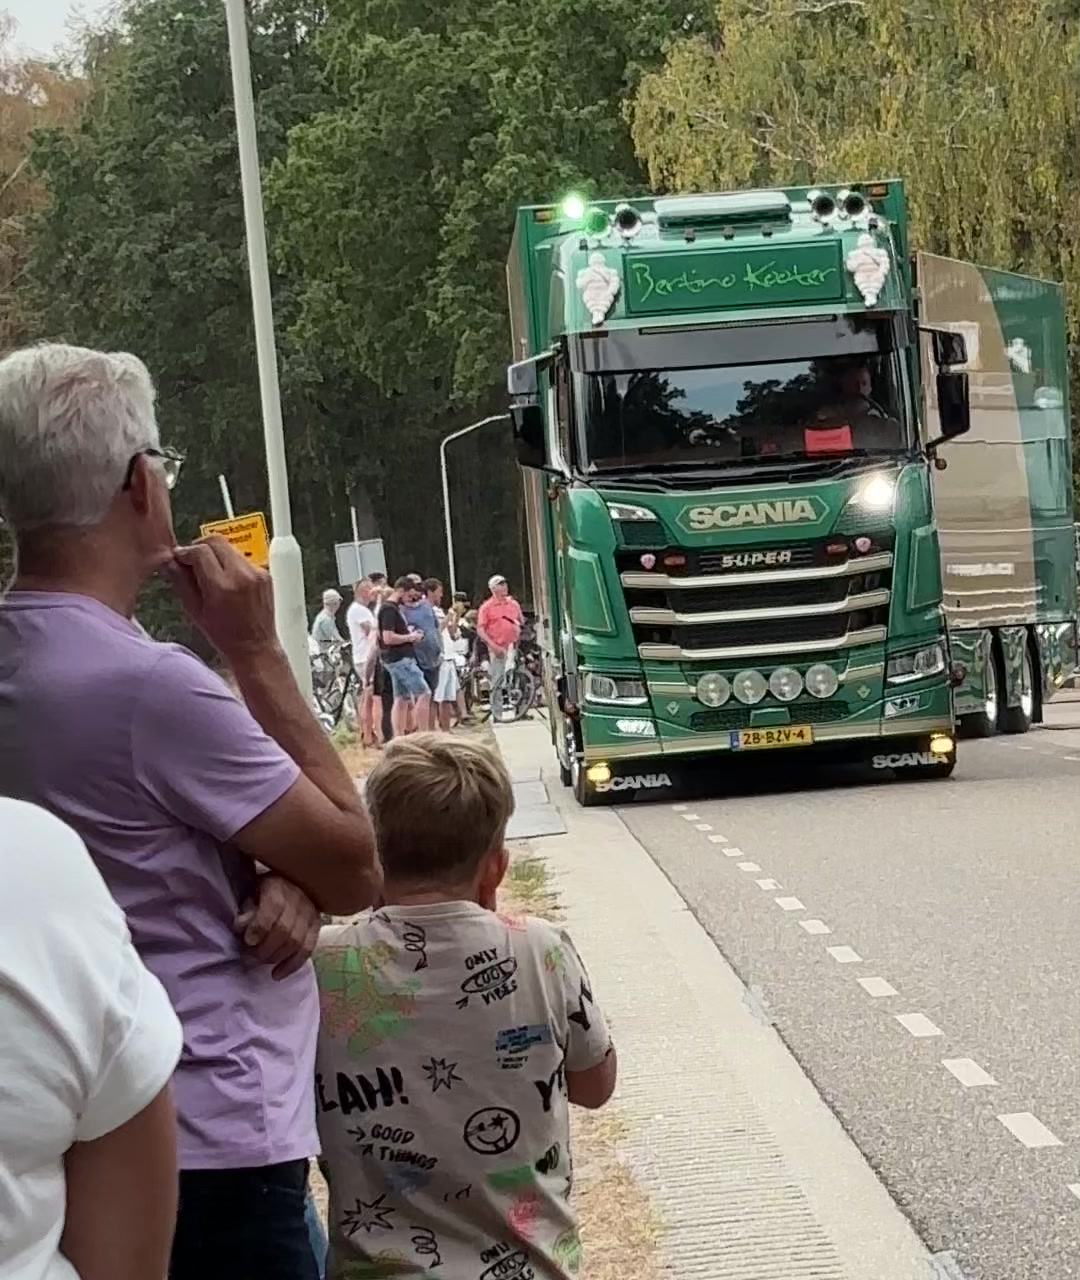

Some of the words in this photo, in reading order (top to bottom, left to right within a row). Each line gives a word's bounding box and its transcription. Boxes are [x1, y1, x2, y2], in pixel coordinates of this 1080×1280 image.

[688, 499, 817, 530] SCANIA
[721, 550, 792, 569] SUPER
[871, 751, 949, 769] SCANIA
[595, 773, 672, 793] SCANIA
[464, 948, 498, 971] ONLY
[482, 979, 518, 1006] VIBES
[370, 1123, 415, 1144] GOOD
